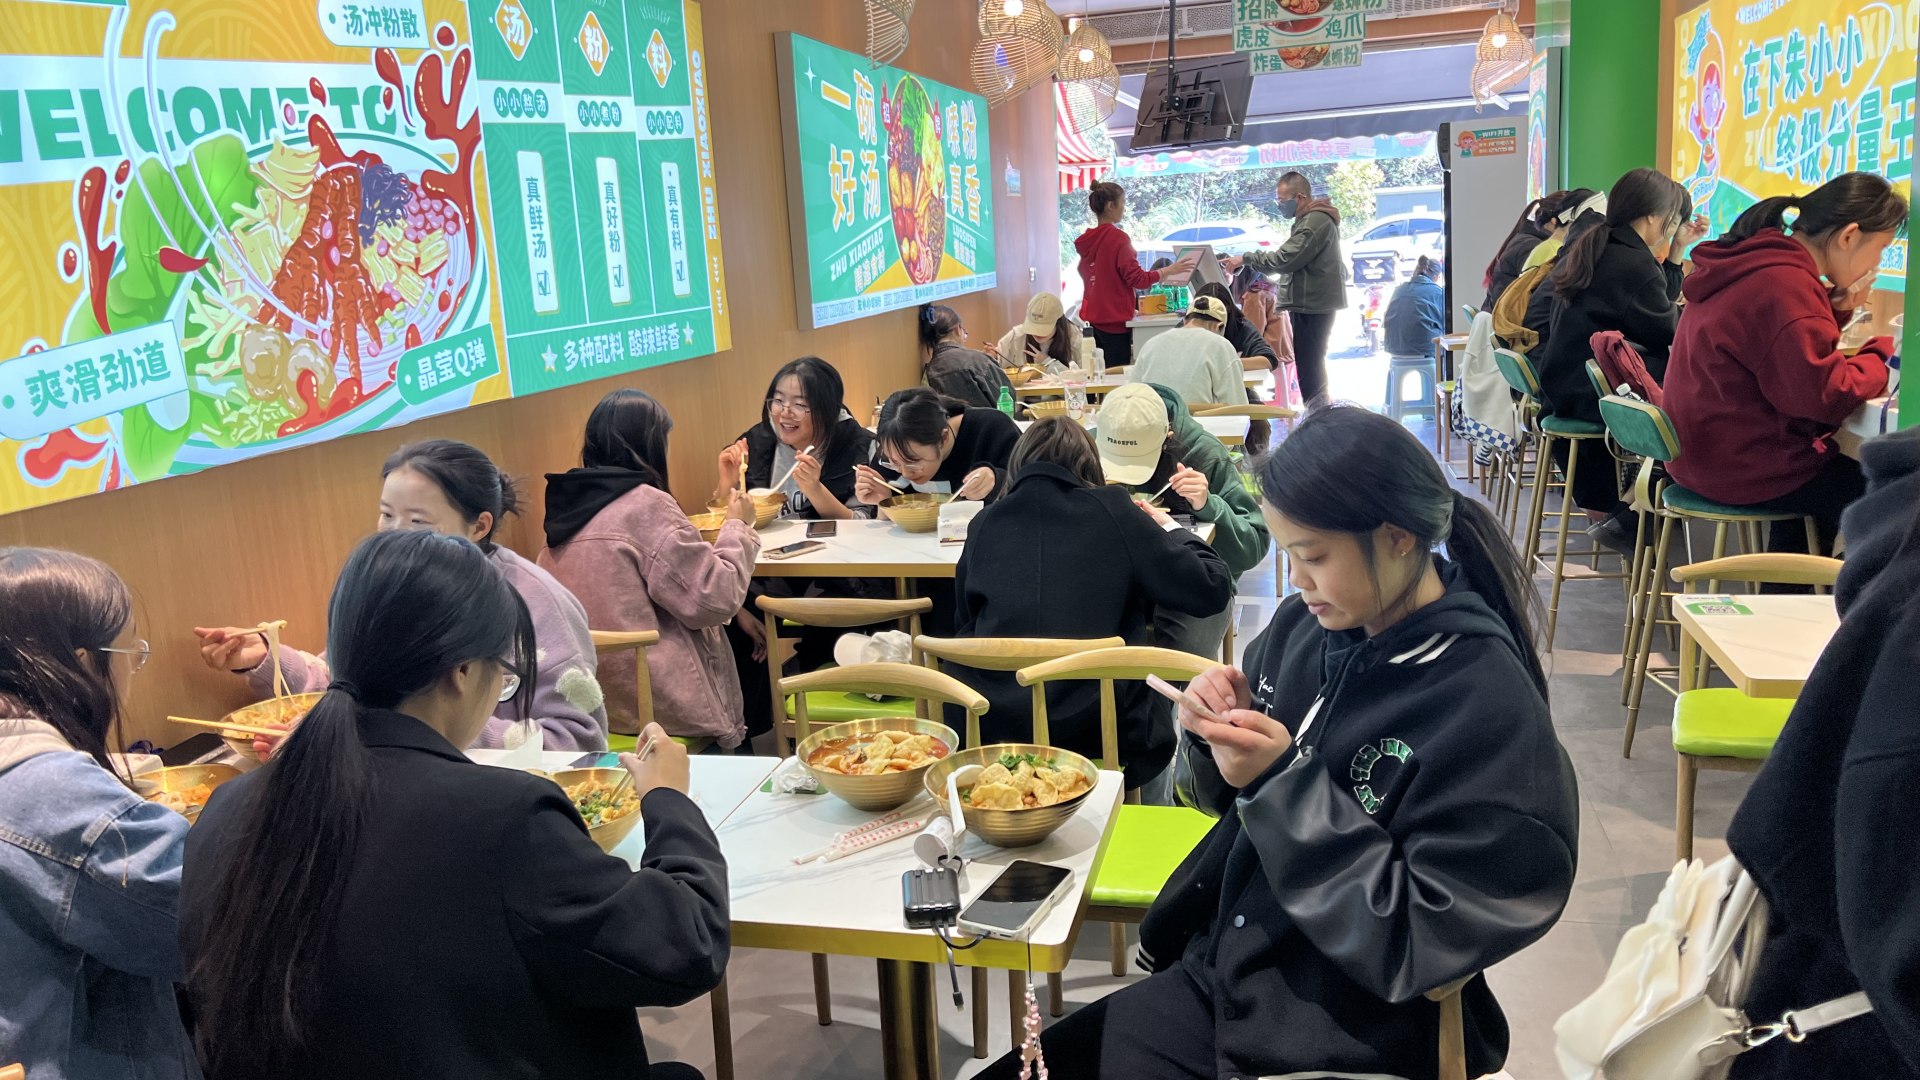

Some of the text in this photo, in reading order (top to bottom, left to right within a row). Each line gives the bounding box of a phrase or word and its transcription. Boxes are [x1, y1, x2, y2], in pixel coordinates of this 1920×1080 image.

[342, 4, 421, 39] 汤冲粉散
[503, 5, 526, 47] 汤
[1236, 13, 1363, 49] 虎皮 鸡爪
[1739, 3, 1774, 24] WELCOME
[584, 25, 604, 64] 粉
[650, 42, 668, 76] 料
[1254, 53, 1283, 73] 炸蛋
[1742, 15, 1864, 119] 在下朱小小
[496, 92, 547, 113] 小小熬汤
[579, 104, 621, 122] 小小煮粉
[647, 114, 683, 130] 小小配料
[820, 69, 878, 146] 一碗
[691, 50, 718, 241] ZHU XIAOXIAO
[1775, 78, 1917, 185] 终极分量王
[829, 143, 981, 232] 好汤 真香
[525, 177, 548, 259] 真鲜汤
[603, 180, 622, 254] 真好粉
[667, 185, 683, 252] 真有料
[830, 226, 884, 282] ZHU XIAOXIAO
[416, 336, 488, 392] 晶莹Q弹
[563, 322, 681, 372] 多种配料 酸辣鲜香
[24, 338, 172, 418] 爽滑劲道
